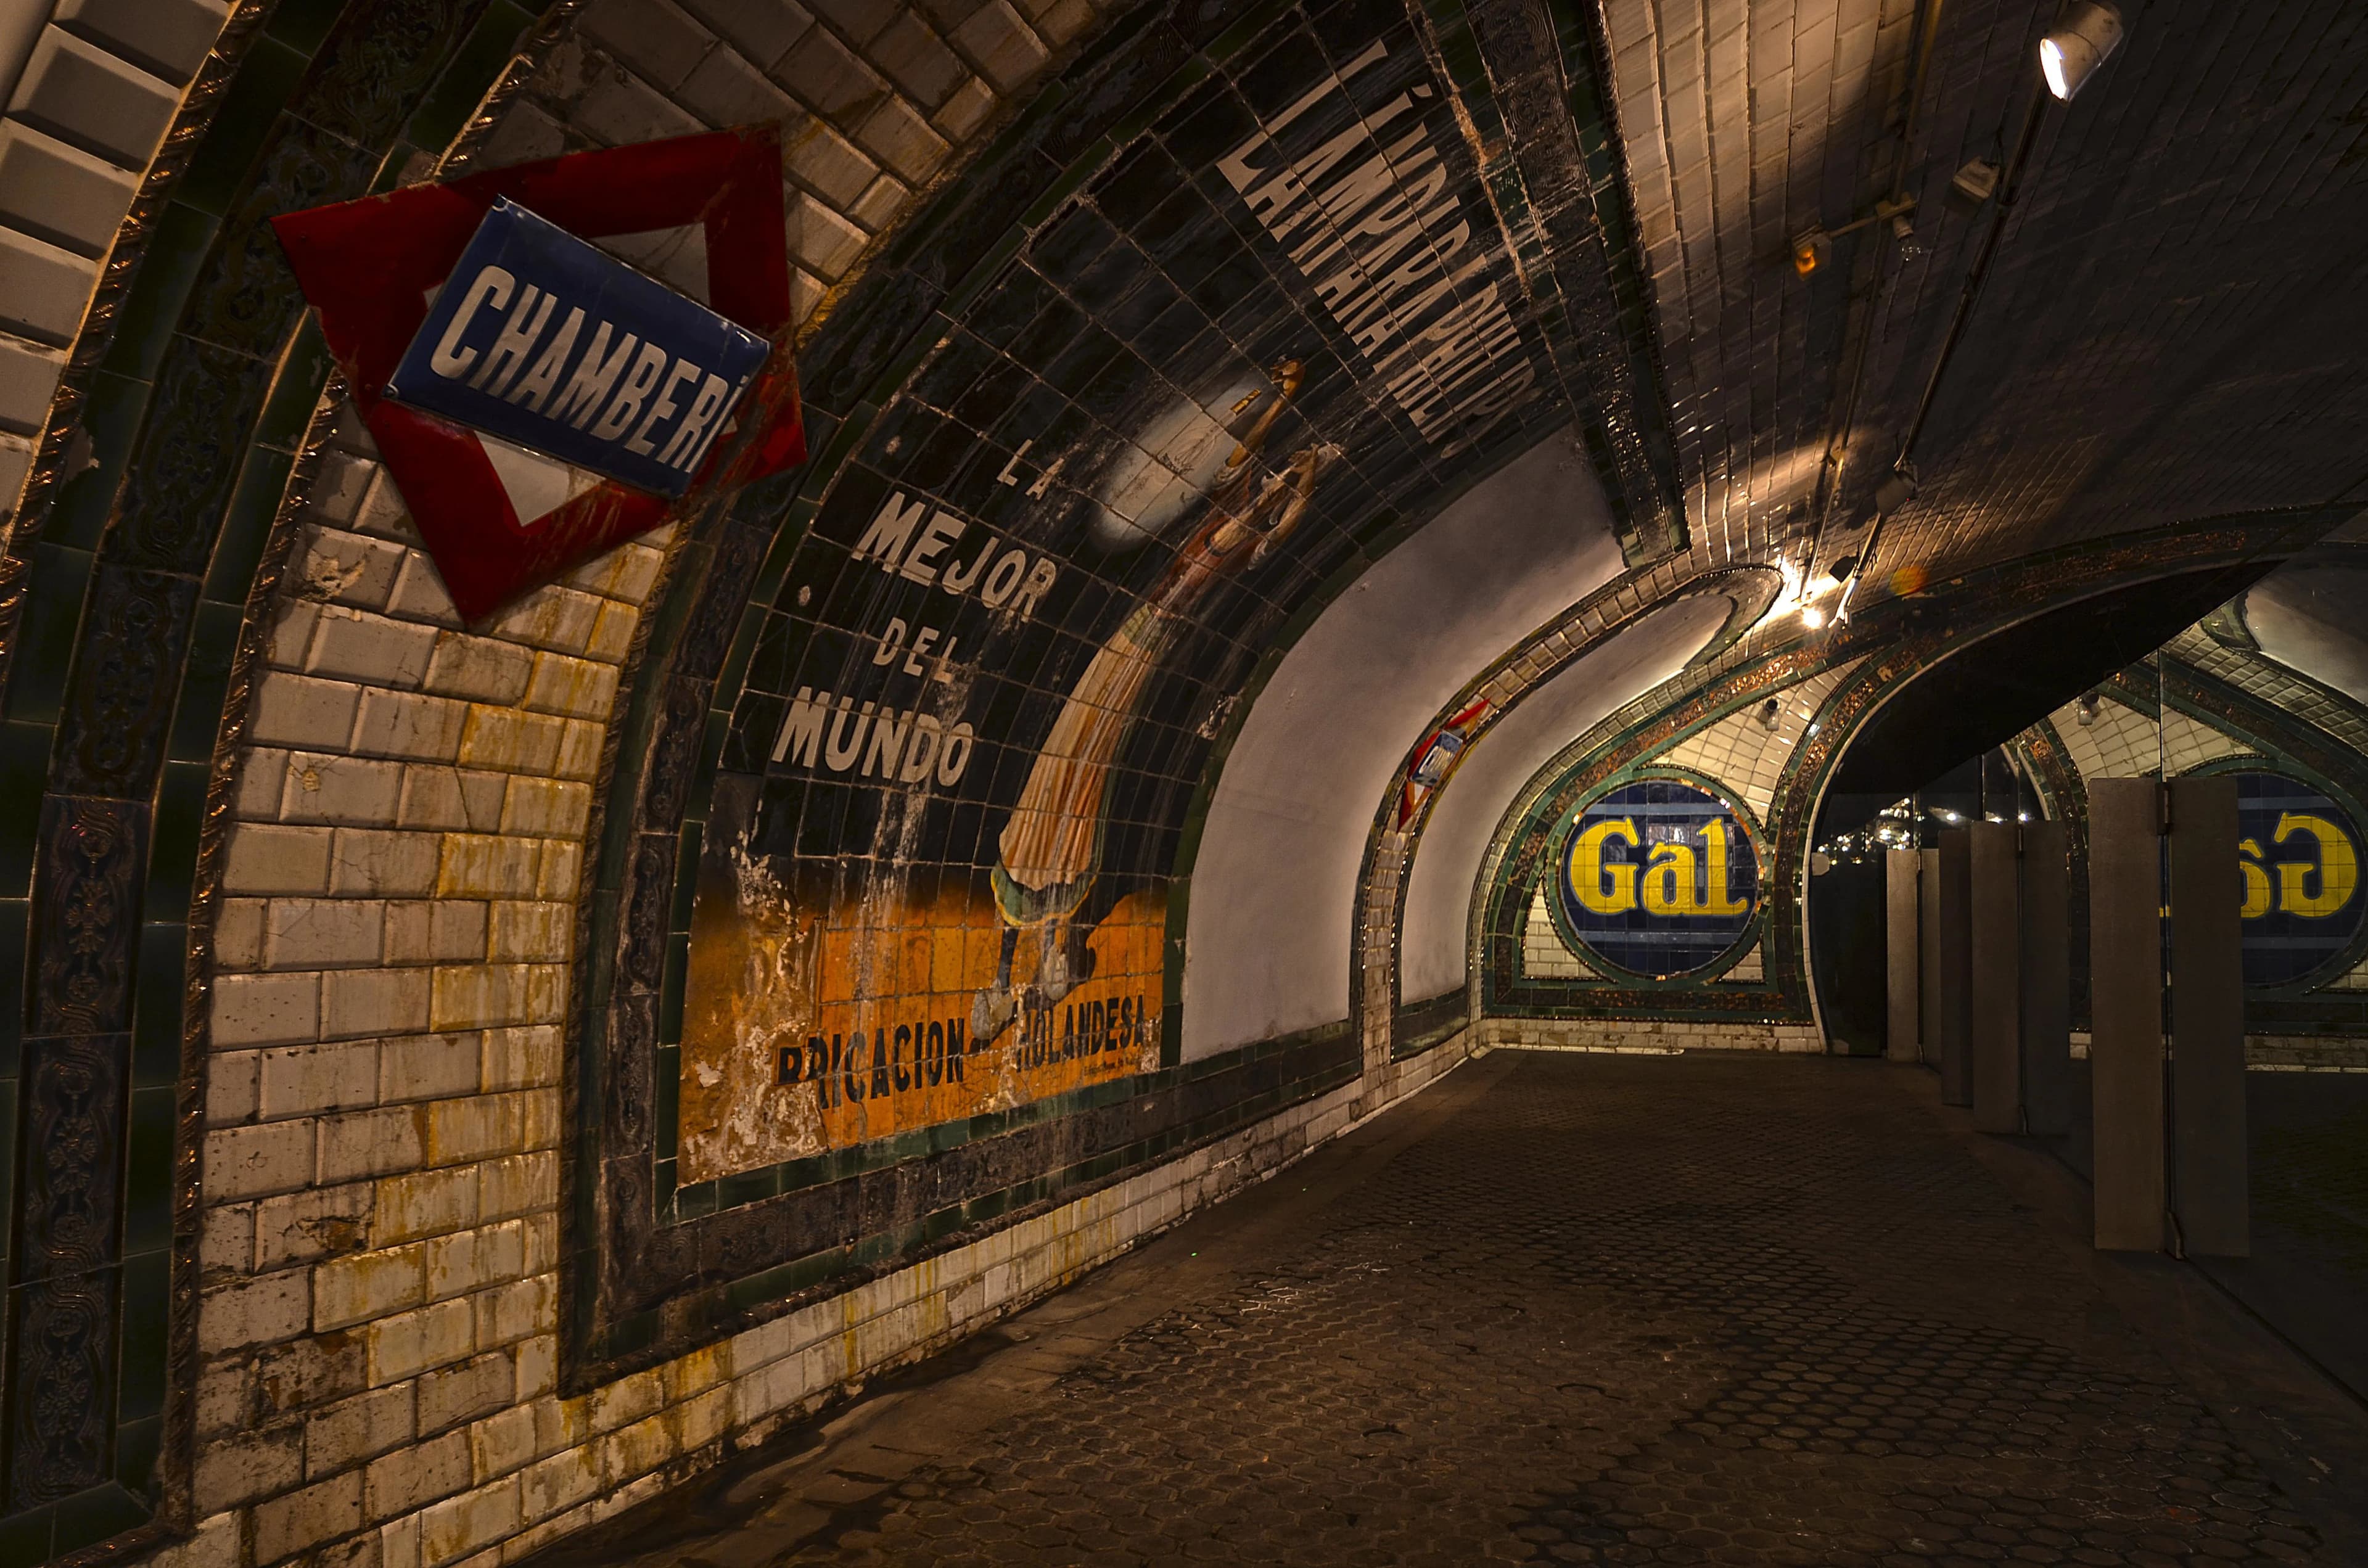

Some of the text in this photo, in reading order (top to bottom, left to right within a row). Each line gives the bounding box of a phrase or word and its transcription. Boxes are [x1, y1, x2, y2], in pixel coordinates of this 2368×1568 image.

[1373, 280, 1540, 459] PHILIPS
[997, 438, 1066, 501] LA
[851, 491, 1057, 623] MEJOR
[871, 617, 958, 683] DEL
[771, 686, 974, 787] MUNDO
[1571, 816, 1748, 916] Gal
